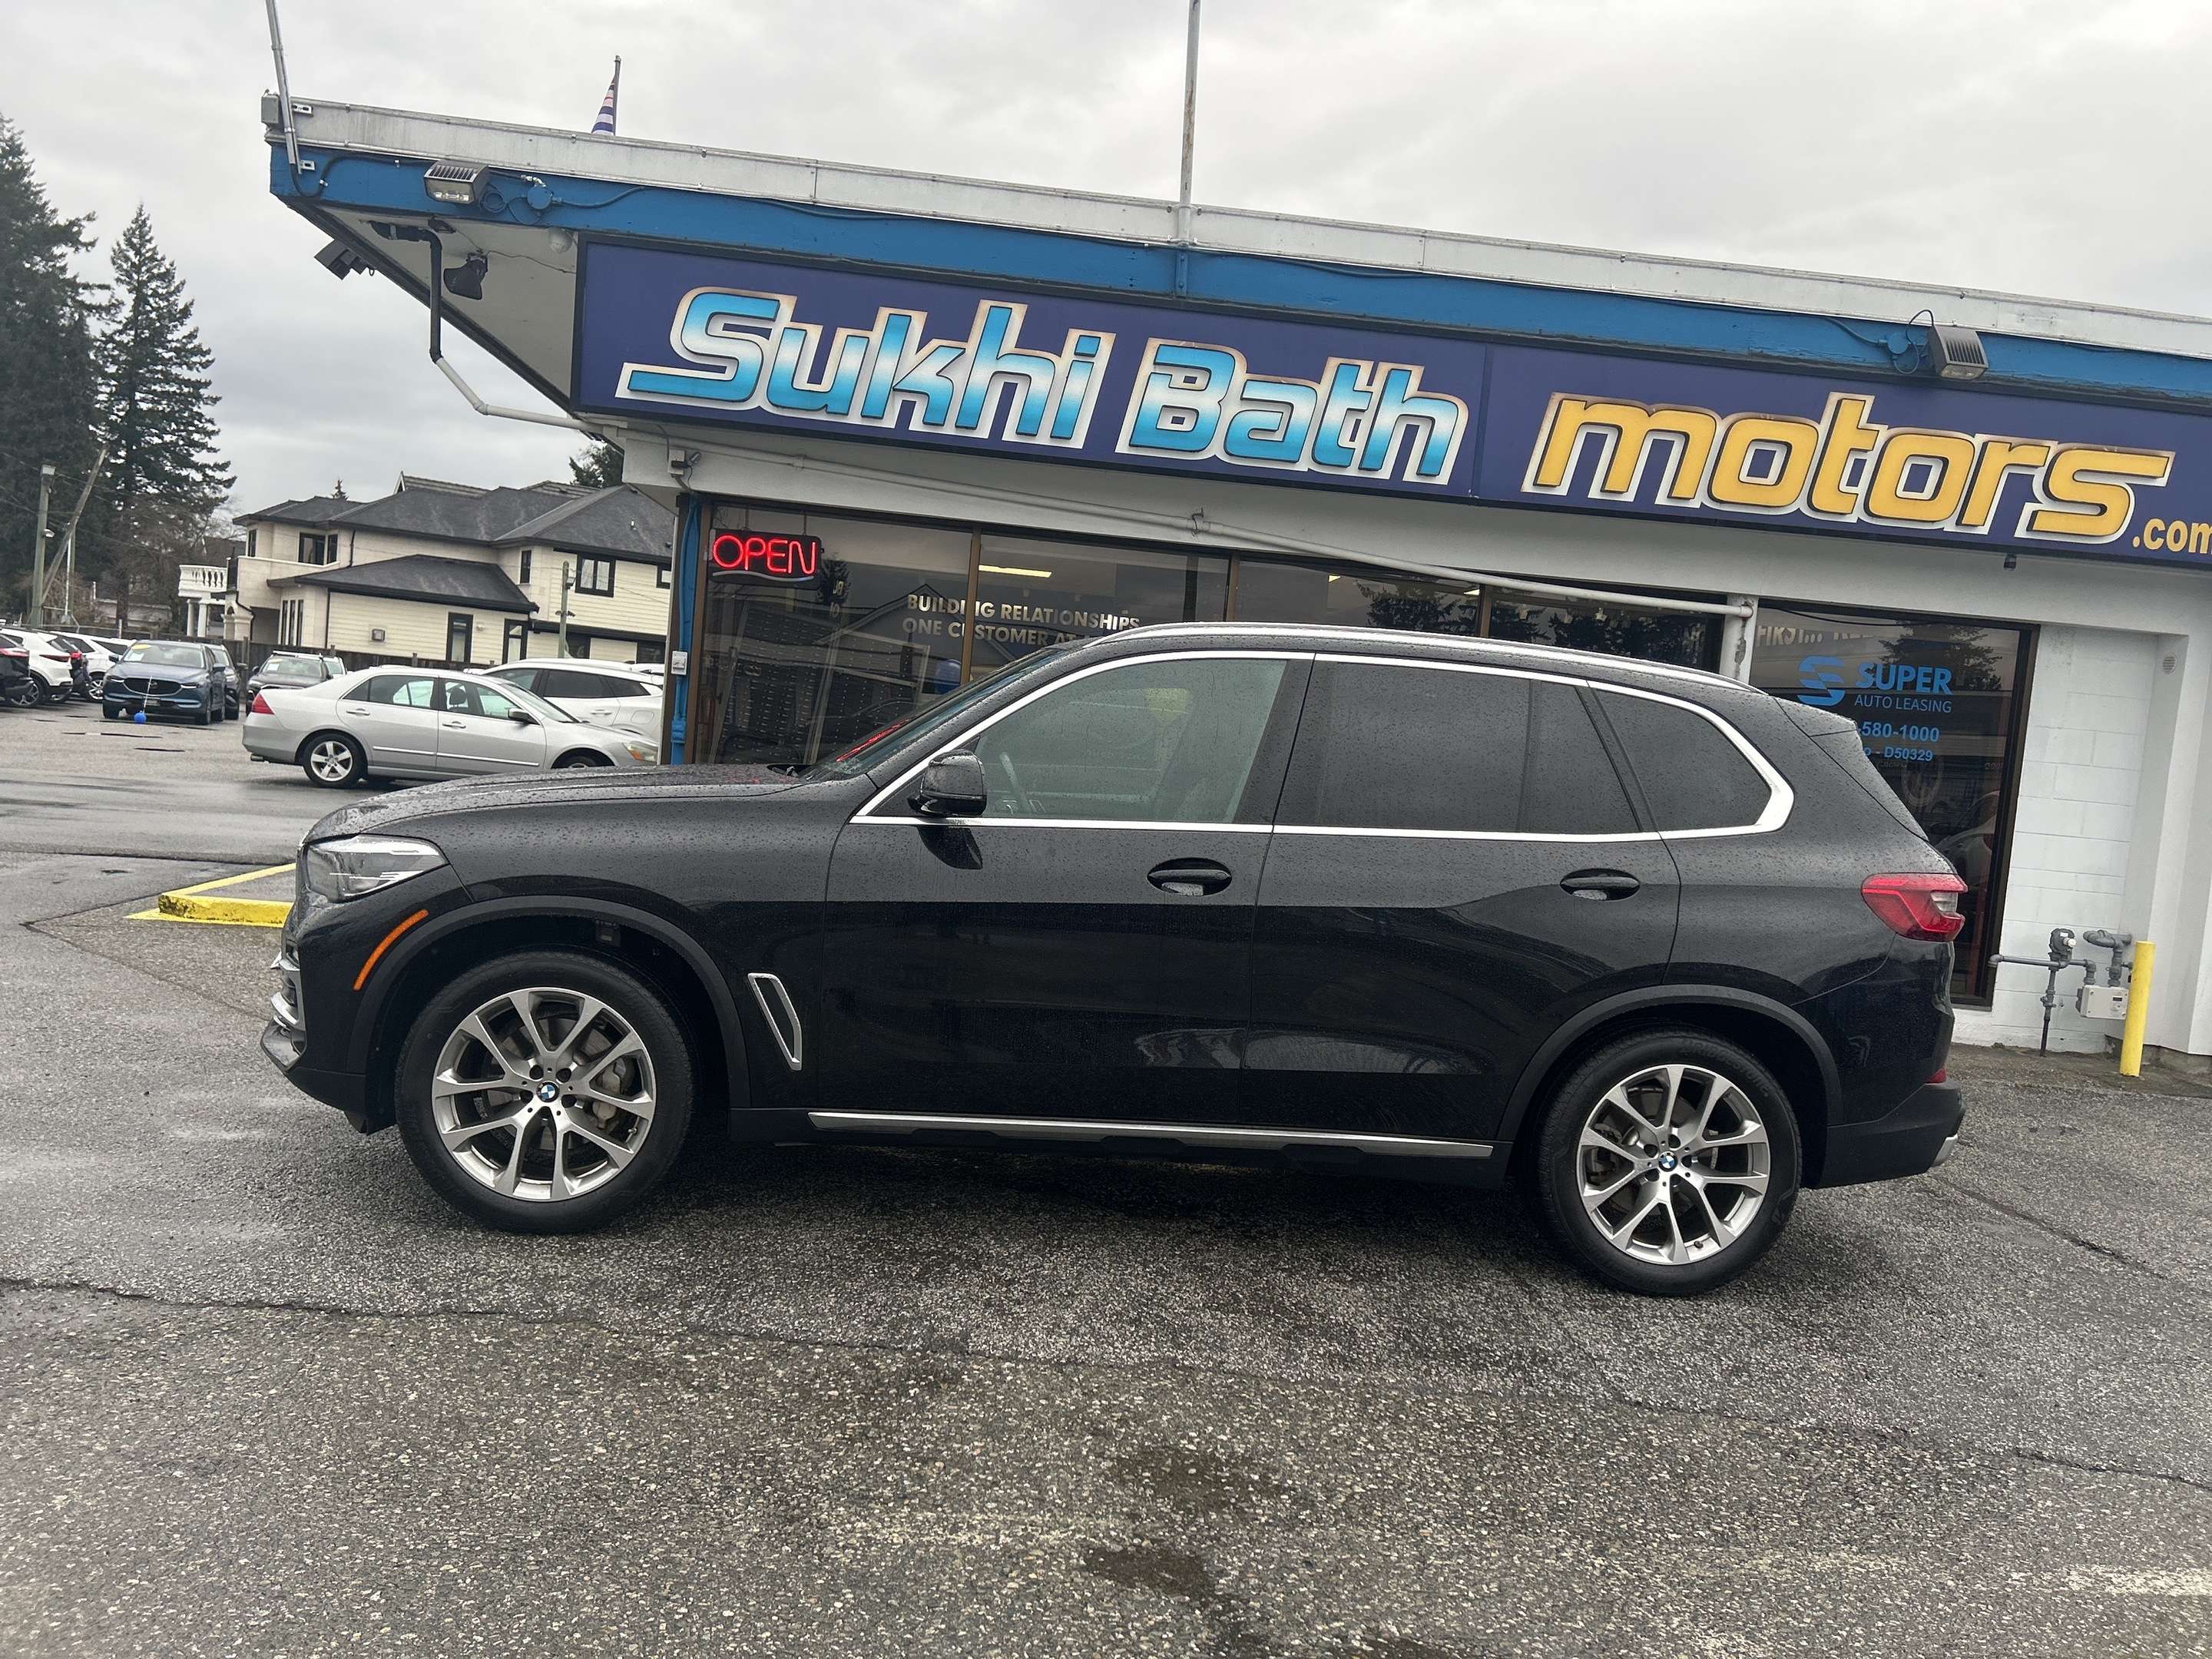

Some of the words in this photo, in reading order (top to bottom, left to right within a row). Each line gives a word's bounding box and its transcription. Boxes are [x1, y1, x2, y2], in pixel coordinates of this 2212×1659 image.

[616, 286, 1115, 448] Sukhi
[1115, 338, 1468, 485] Bath
[1522, 392, 2175, 544] motors
[713, 535, 816, 575] OPEN
[902, 618, 942, 636] ONE
[1001, 601, 1141, 630] RELATIONSHIPS
[1856, 662, 1953, 695] SUPER
[1855, 694, 1892, 709] AUTO
[1896, 697, 1952, 713] LEASING
[1884, 747, 1934, 761] D50329
